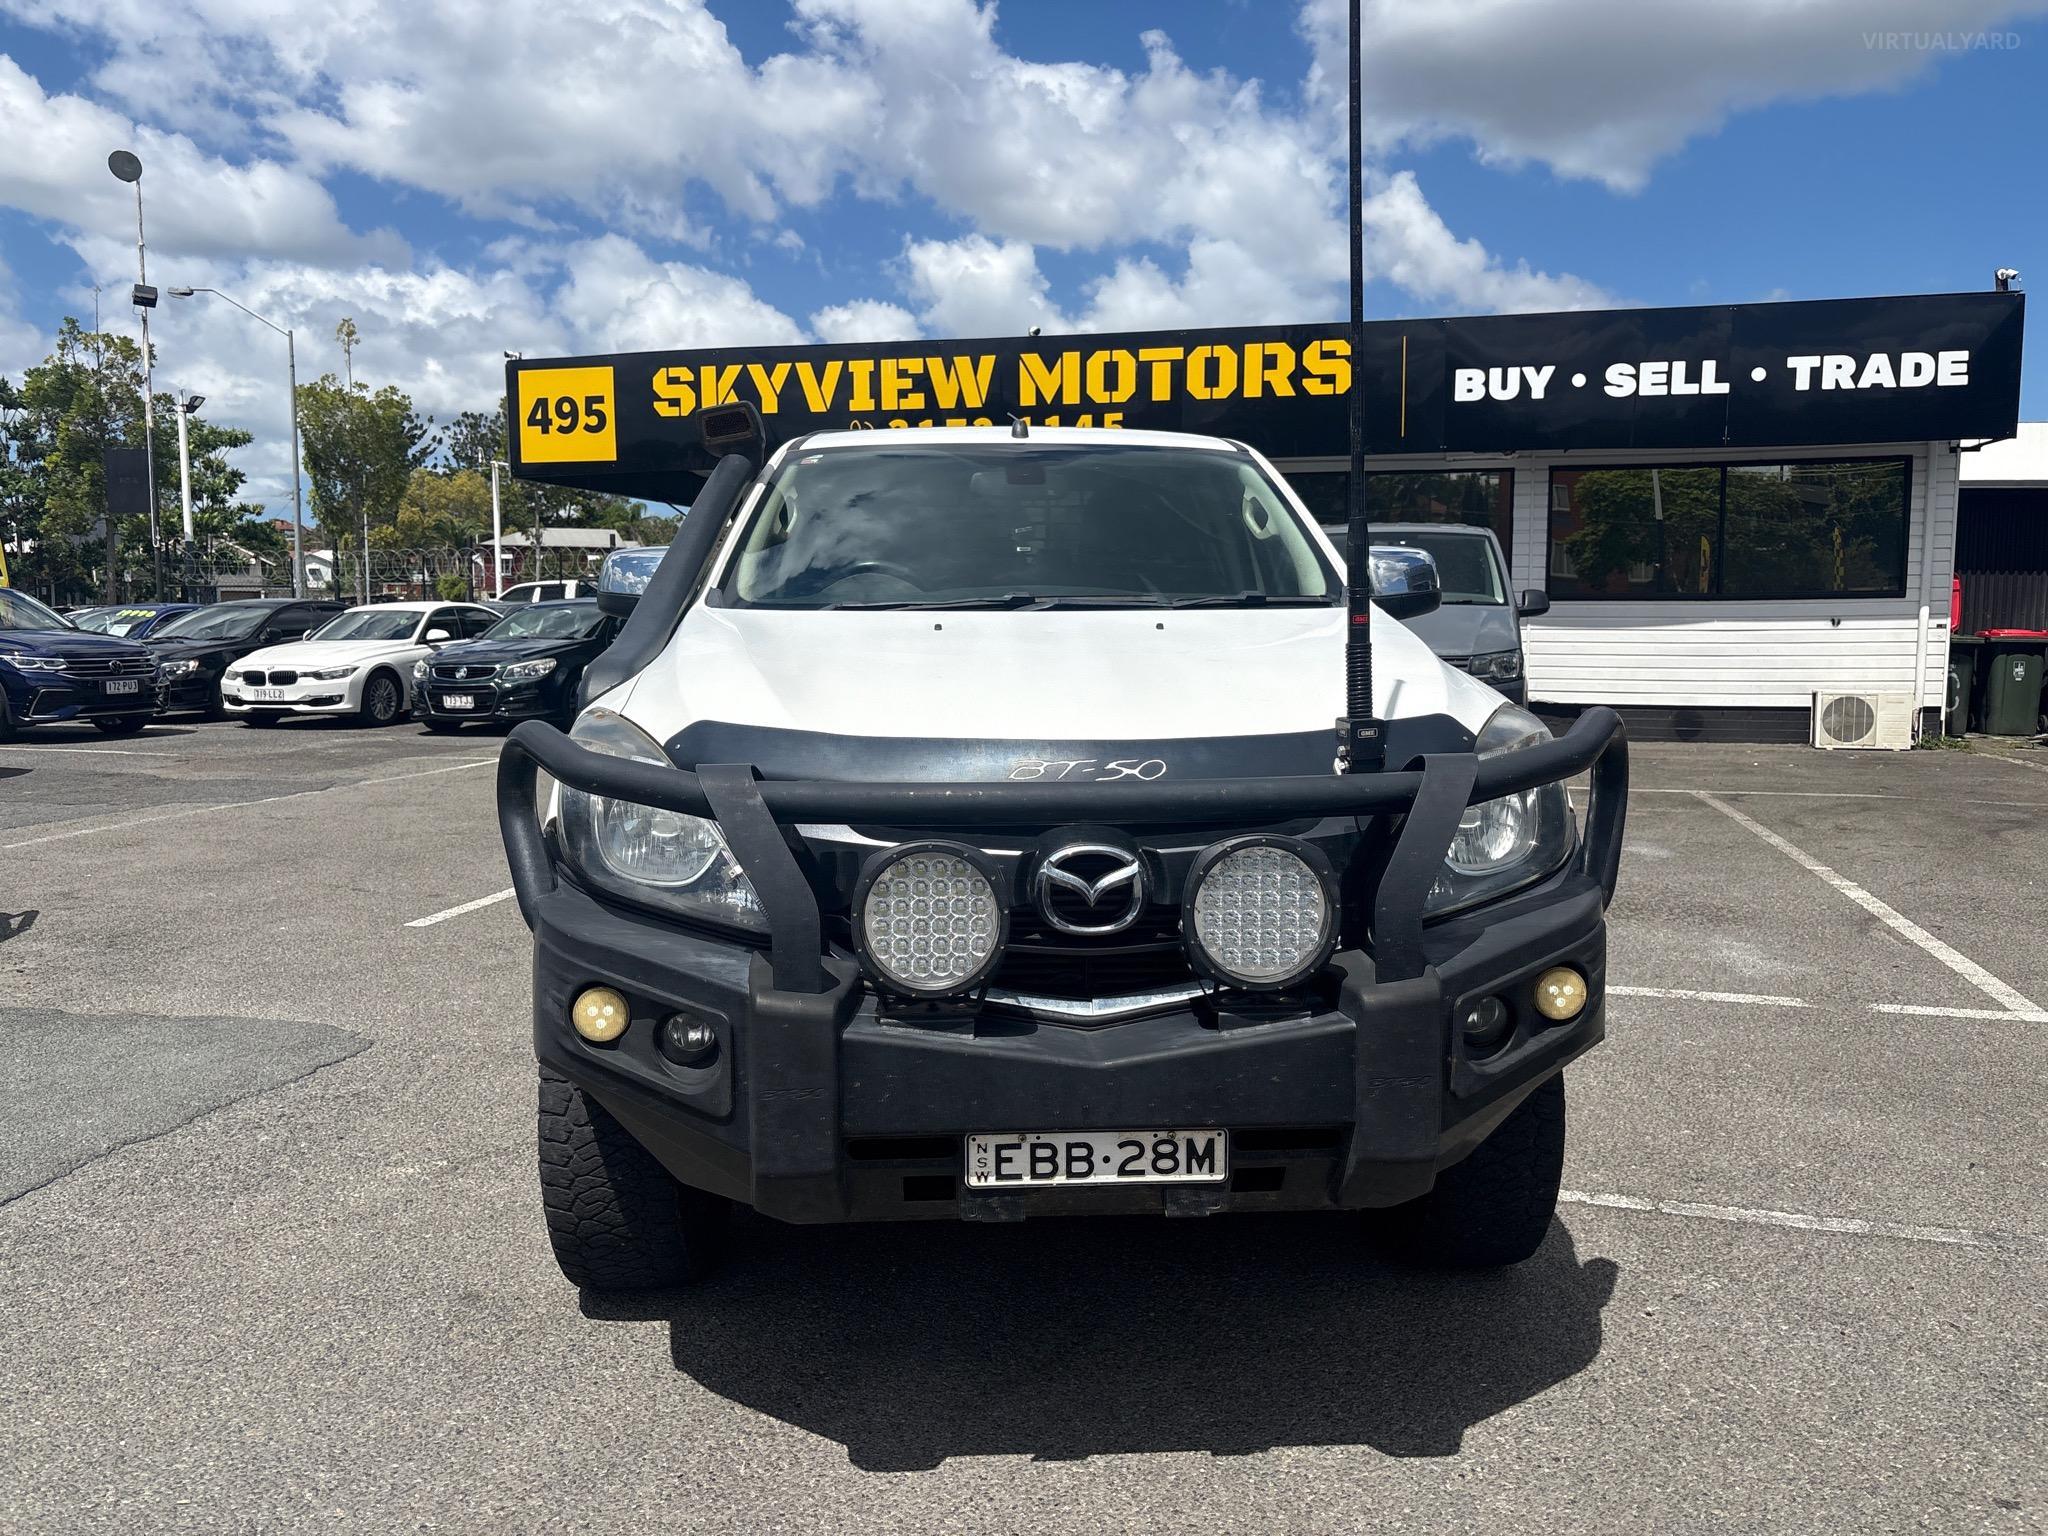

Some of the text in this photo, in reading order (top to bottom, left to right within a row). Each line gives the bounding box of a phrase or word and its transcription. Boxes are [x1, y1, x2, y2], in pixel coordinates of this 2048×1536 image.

[651, 339, 1352, 417] SKYVIEW MOTORS
[1454, 350, 1969, 402] BUY SELL TRADE
[527, 396, 607, 435] 495
[1008, 760, 1167, 781] BT-50
